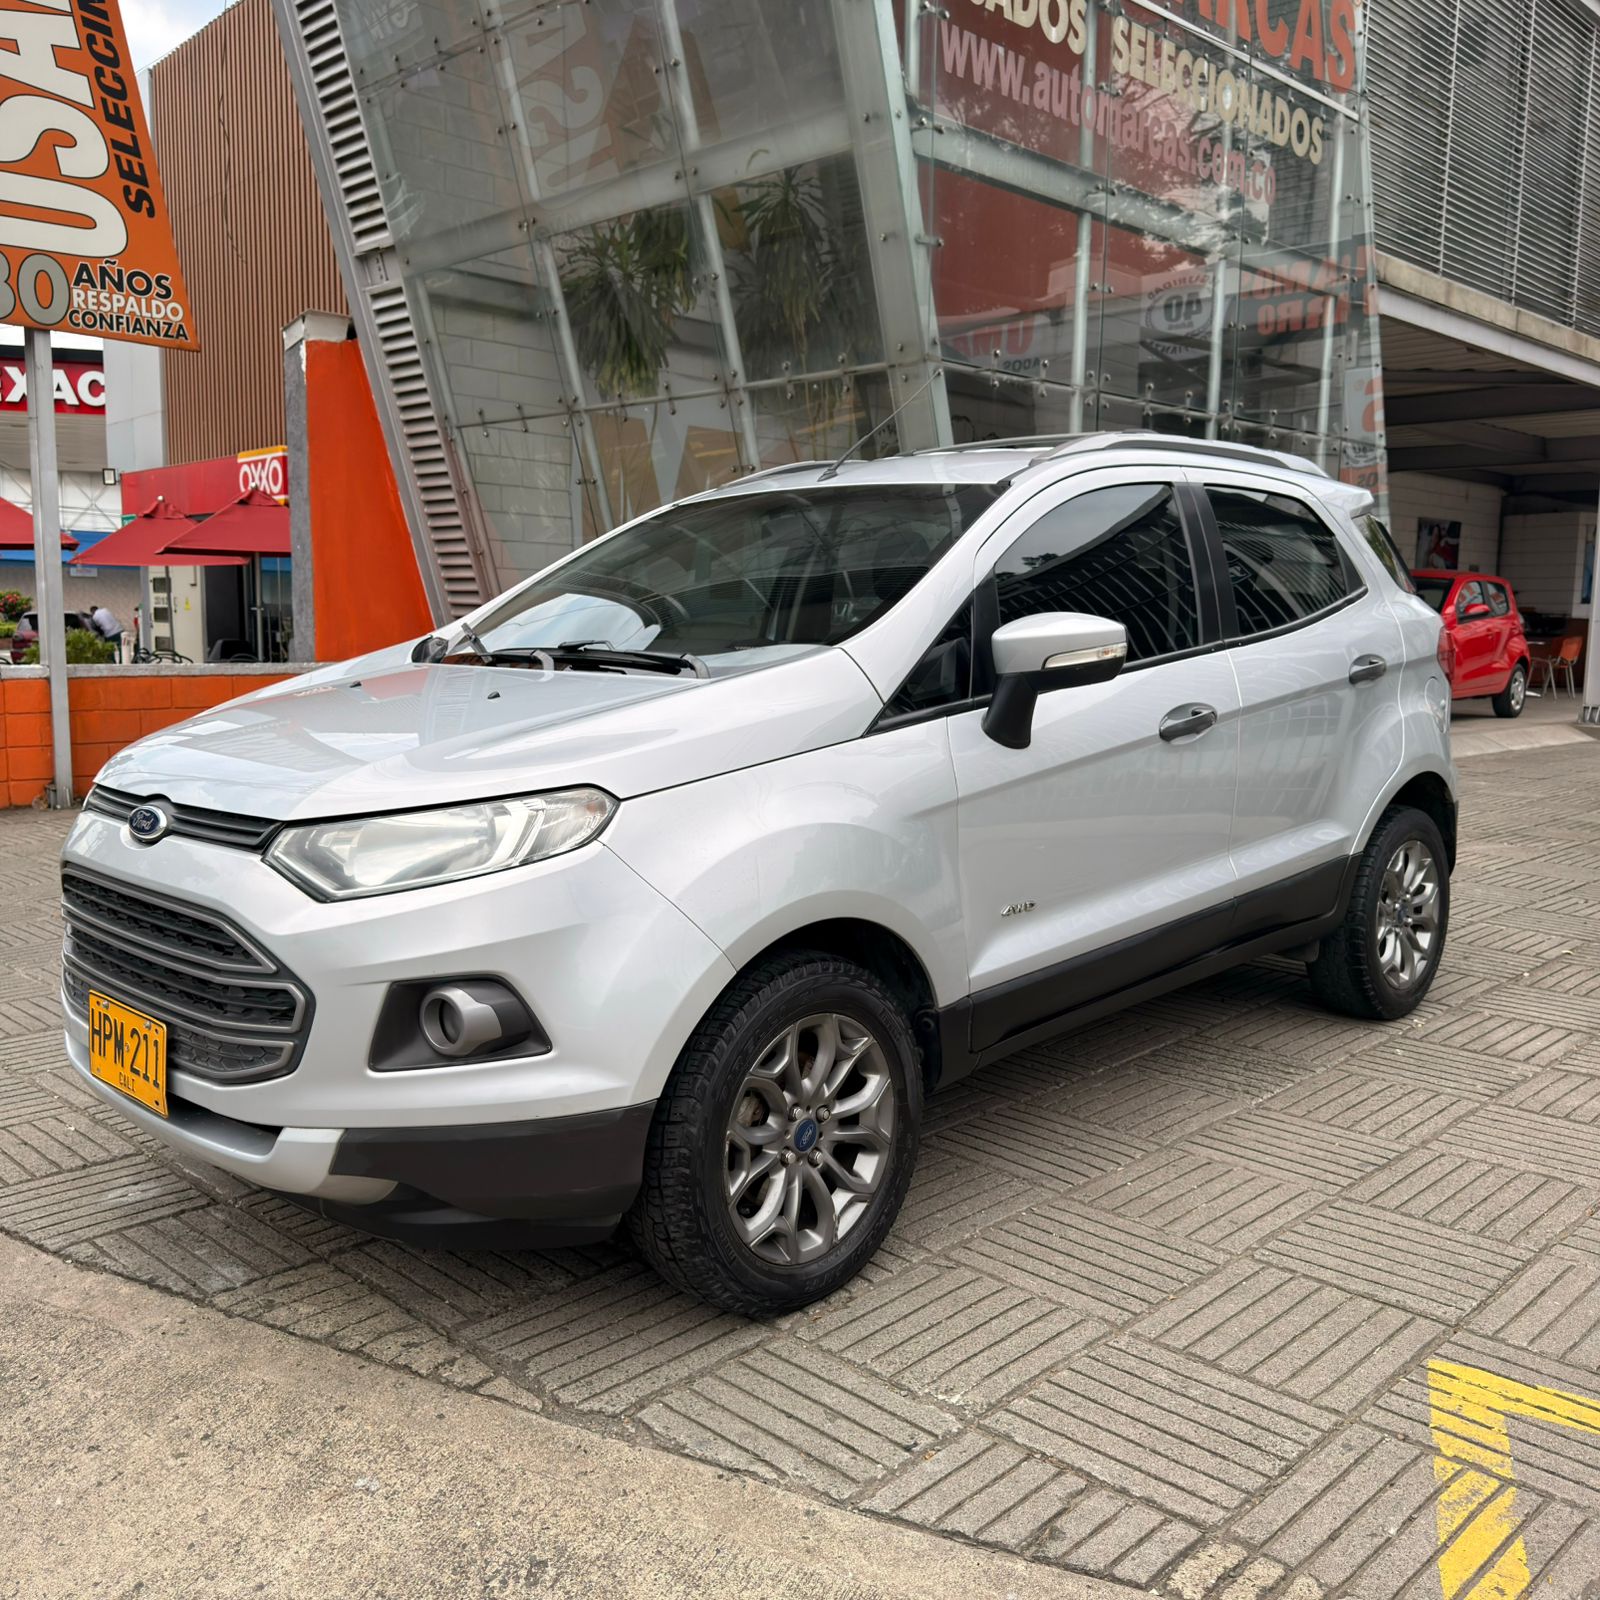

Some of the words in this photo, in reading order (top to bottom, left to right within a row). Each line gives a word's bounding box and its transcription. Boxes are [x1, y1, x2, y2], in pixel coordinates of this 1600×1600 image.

[1111, 17, 1323, 164] SELECCIONADOS
[0, 0, 128, 258] USA
[73, 259, 172, 301] AÑOS
[68, 309, 189, 341] CONFIANZA
[72, 289, 183, 322] RESPALDO
[239, 458, 283, 494] OXXO
[91, 1008, 124, 1068] HPM
[130, 1027, 160, 1088] 211
